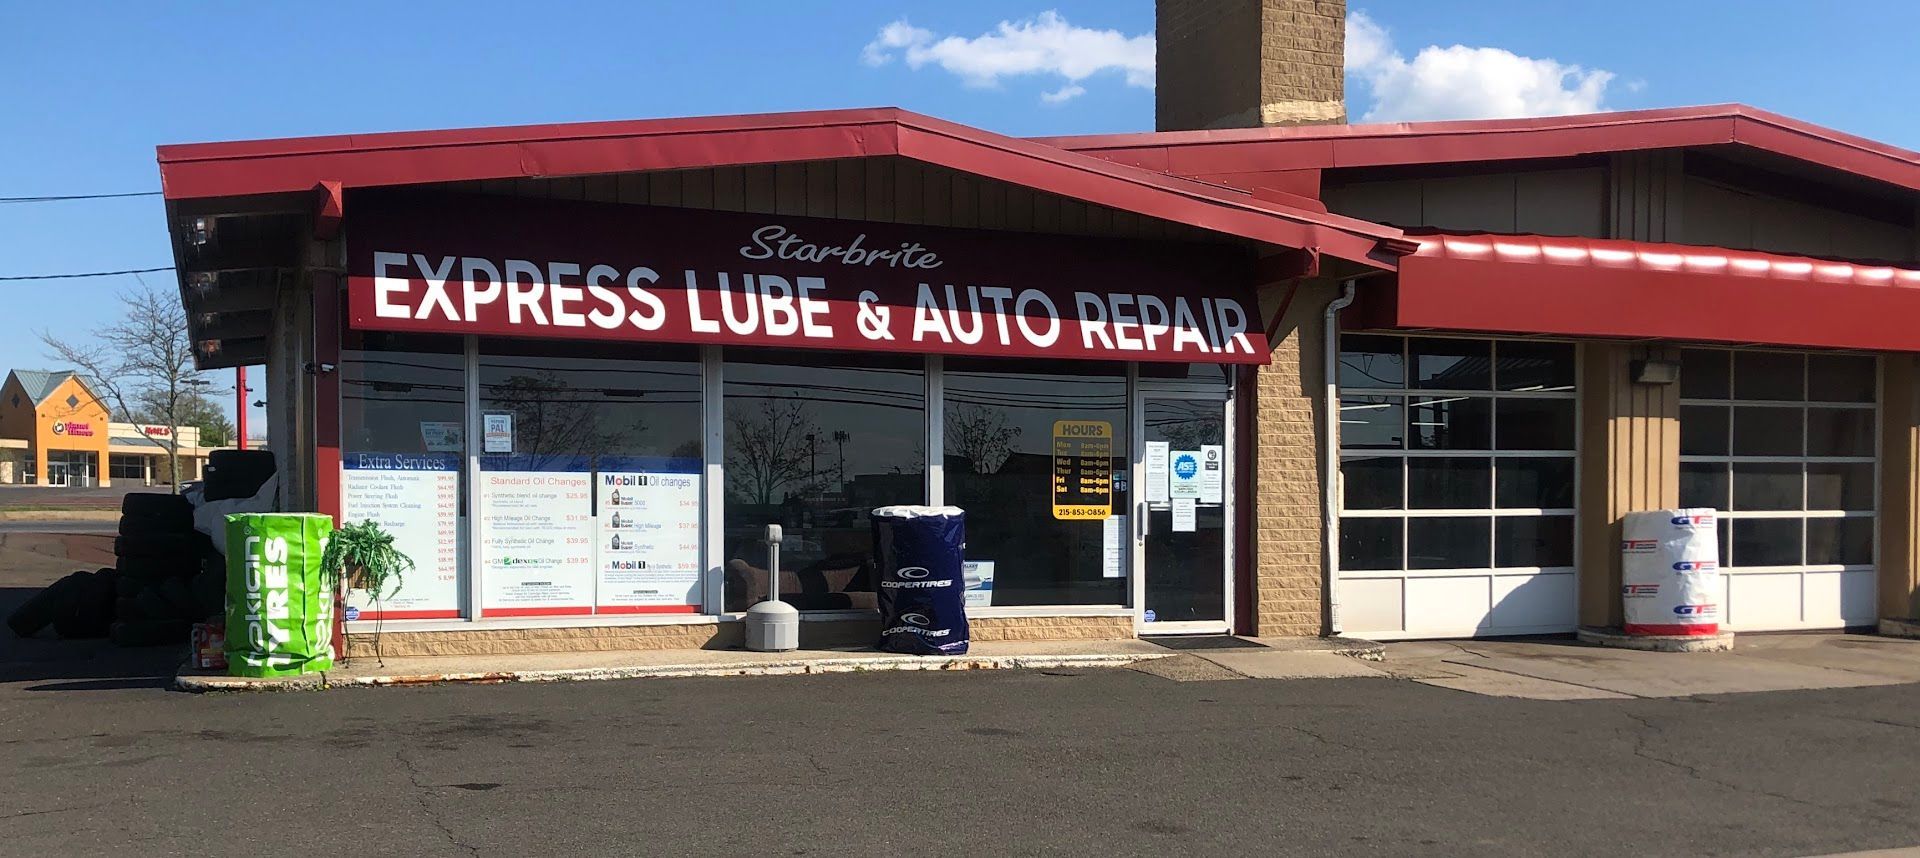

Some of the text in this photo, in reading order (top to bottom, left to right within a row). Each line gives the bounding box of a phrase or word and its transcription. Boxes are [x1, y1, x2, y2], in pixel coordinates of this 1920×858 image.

[739, 225, 943, 269] Starbrite
[374, 251, 1255, 354] EXPRESS LUBE & AUTO REPAIR
[491, 424, 505, 432] PAL
[1063, 425, 1103, 436] HOURS
[358, 454, 446, 470] Extra Services
[1178, 462, 1195, 471] ASE
[491, 477, 586, 487] Standard Oil Changes
[605, 475, 691, 489] Mobil 1 Oil changes
[1671, 516, 1707, 525] GT
[612, 561, 637, 569] Mobil
[639, 561, 645, 569] 1
[1672, 561, 1708, 571] GT
[265, 536, 292, 668] TYRES
[1673, 604, 1709, 614] GT
